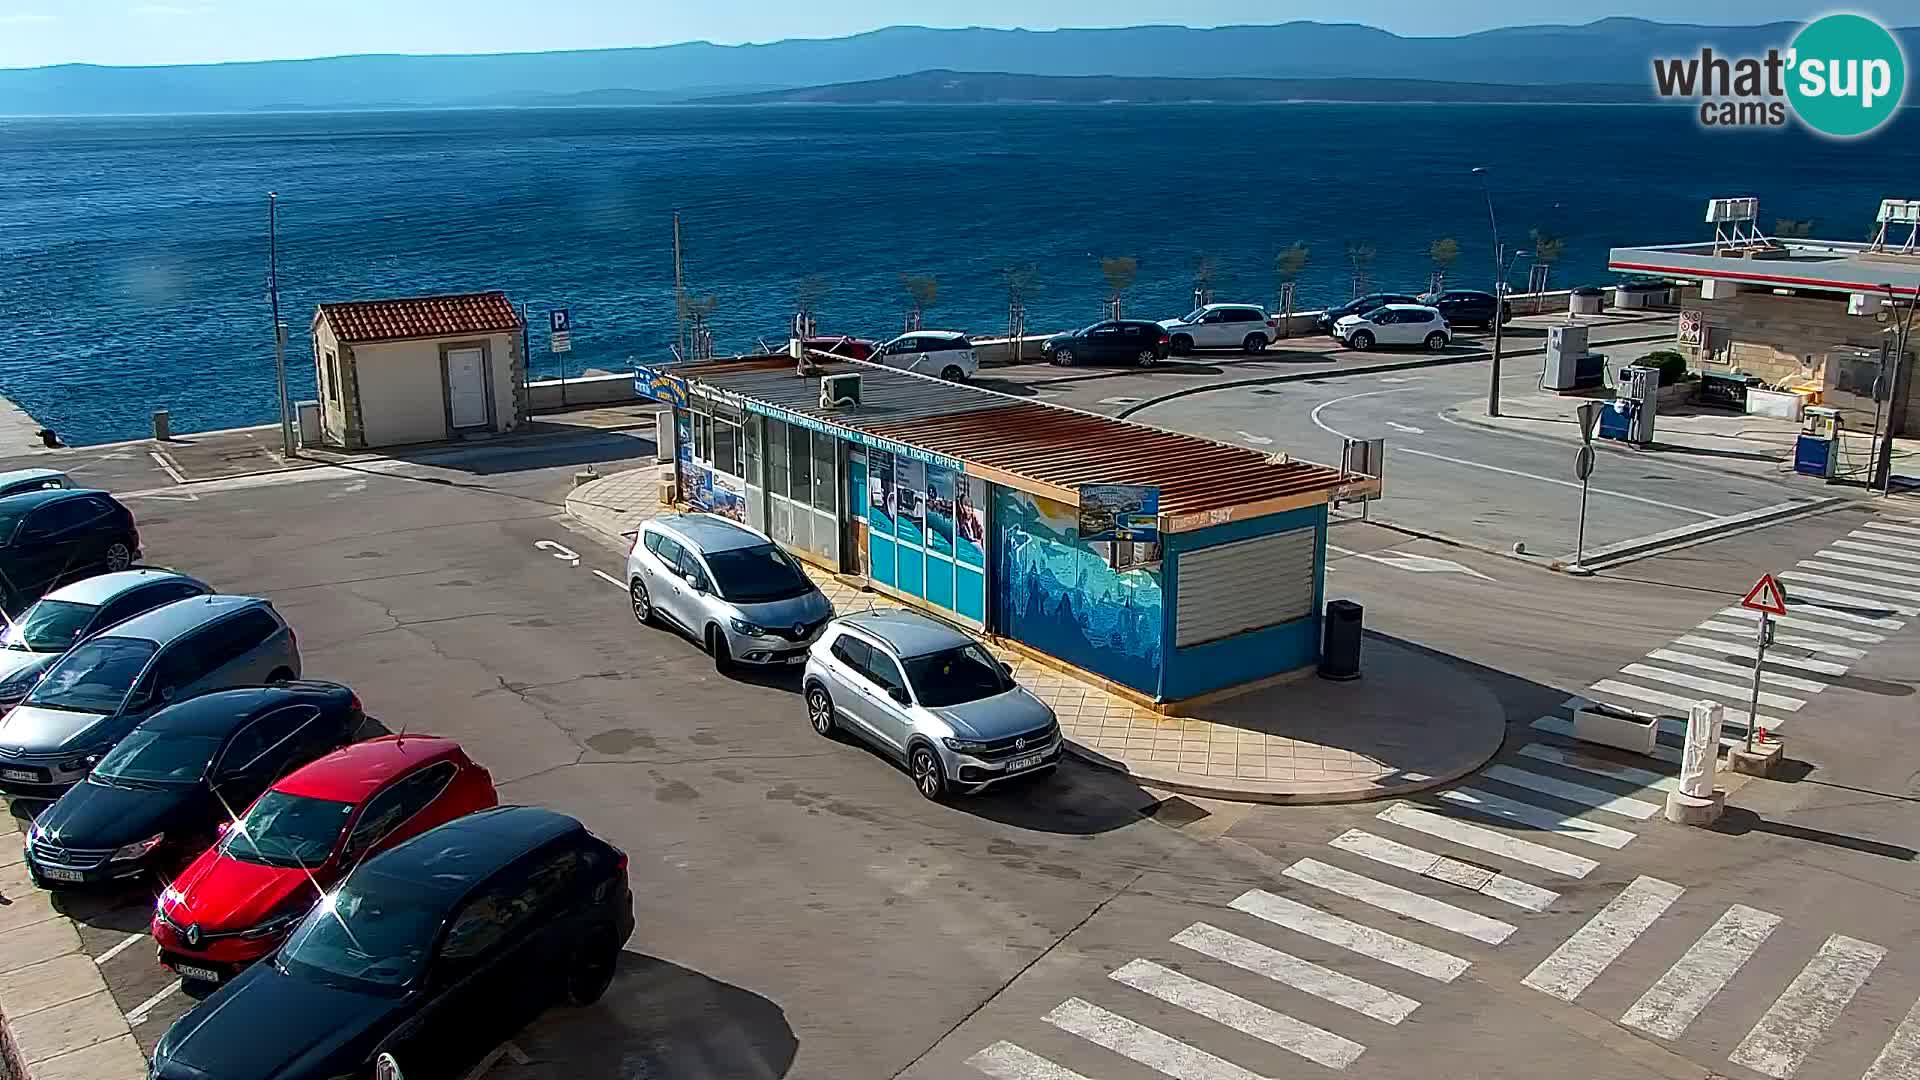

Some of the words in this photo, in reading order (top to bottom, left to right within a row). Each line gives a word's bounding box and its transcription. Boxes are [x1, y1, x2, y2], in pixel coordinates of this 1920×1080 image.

[554, 312, 565, 329] P
[766, 406, 787, 421] KARATA
[824, 423, 853, 440] POSTAJA
[862, 434, 877, 447] BUS
[877, 438, 908, 456] STATION
[909, 447, 933, 463] TICKET
[935, 455, 960, 470] OFFICE
